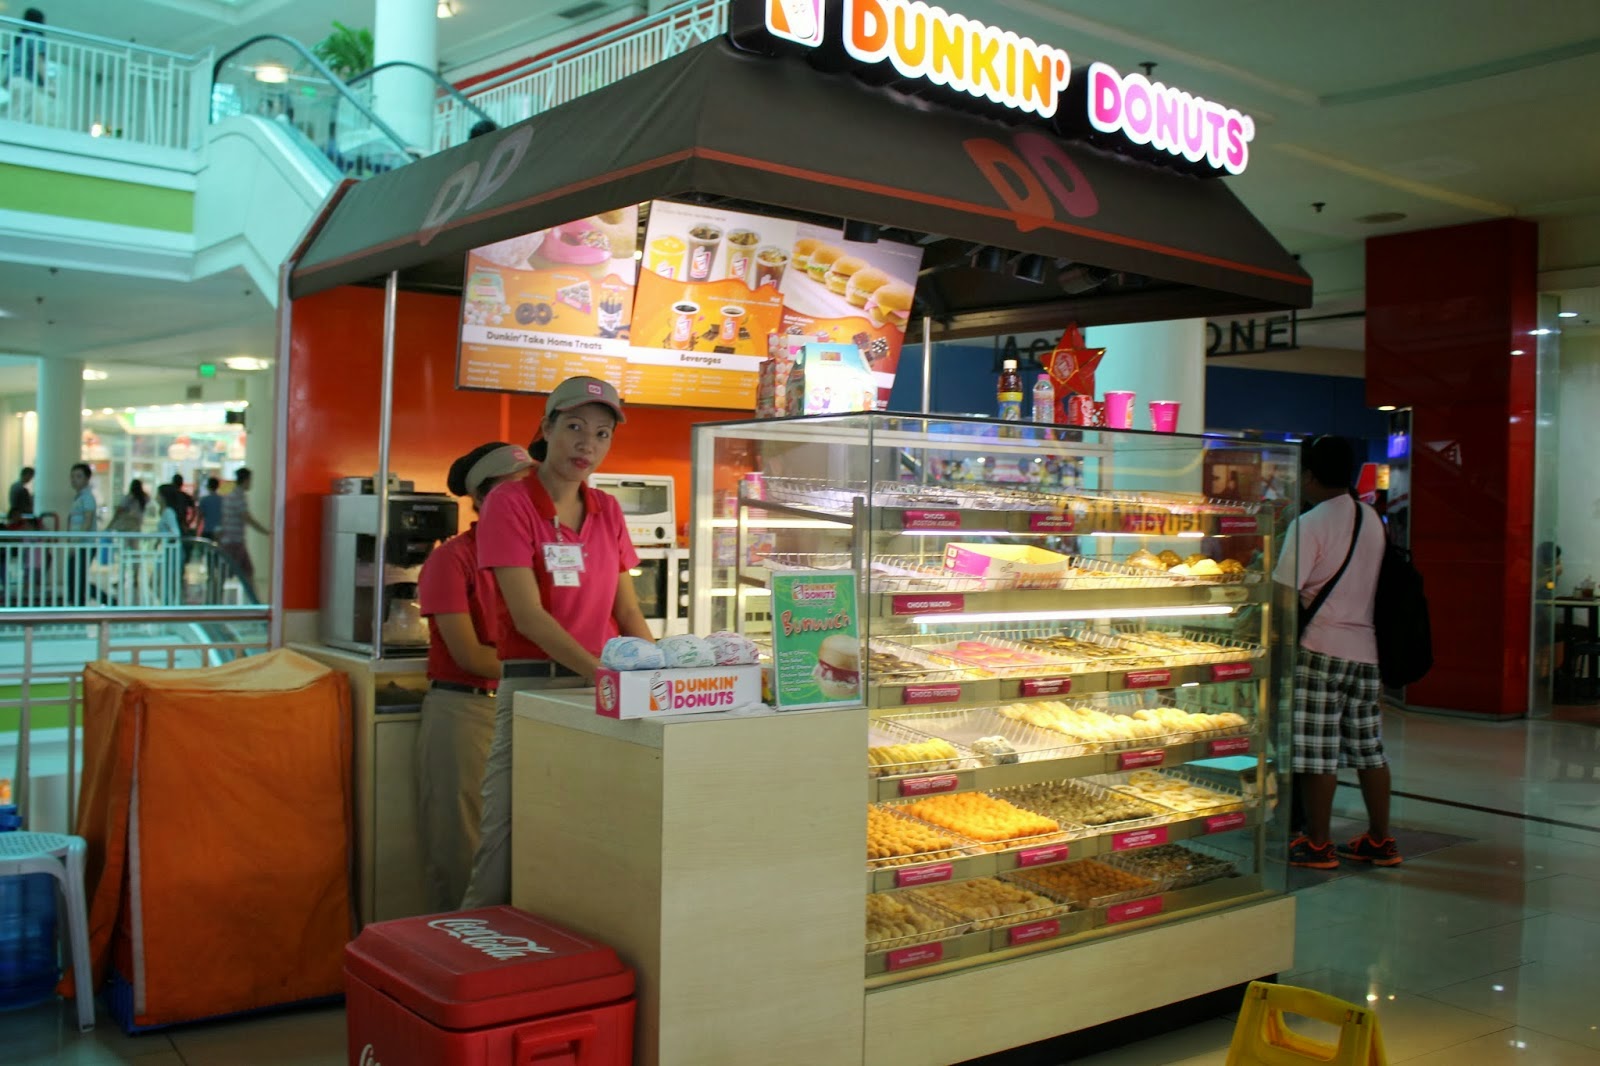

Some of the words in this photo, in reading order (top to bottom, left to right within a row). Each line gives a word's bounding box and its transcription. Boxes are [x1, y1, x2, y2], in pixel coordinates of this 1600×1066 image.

[850, 0, 1064, 108] DUNKIN'
[1095, 69, 1246, 169] DONUTS
[486, 331, 522, 343] Dunkin'
[523, 334, 546, 345] Take
[547, 337, 573, 347] Home
[575, 340, 602, 350] Treats
[680, 353, 722, 366] Beverages
[804, 591, 836, 600] DONUTS
[675, 675, 738, 694] DUNKIN'
[674, 691, 734, 709] DONUTS
